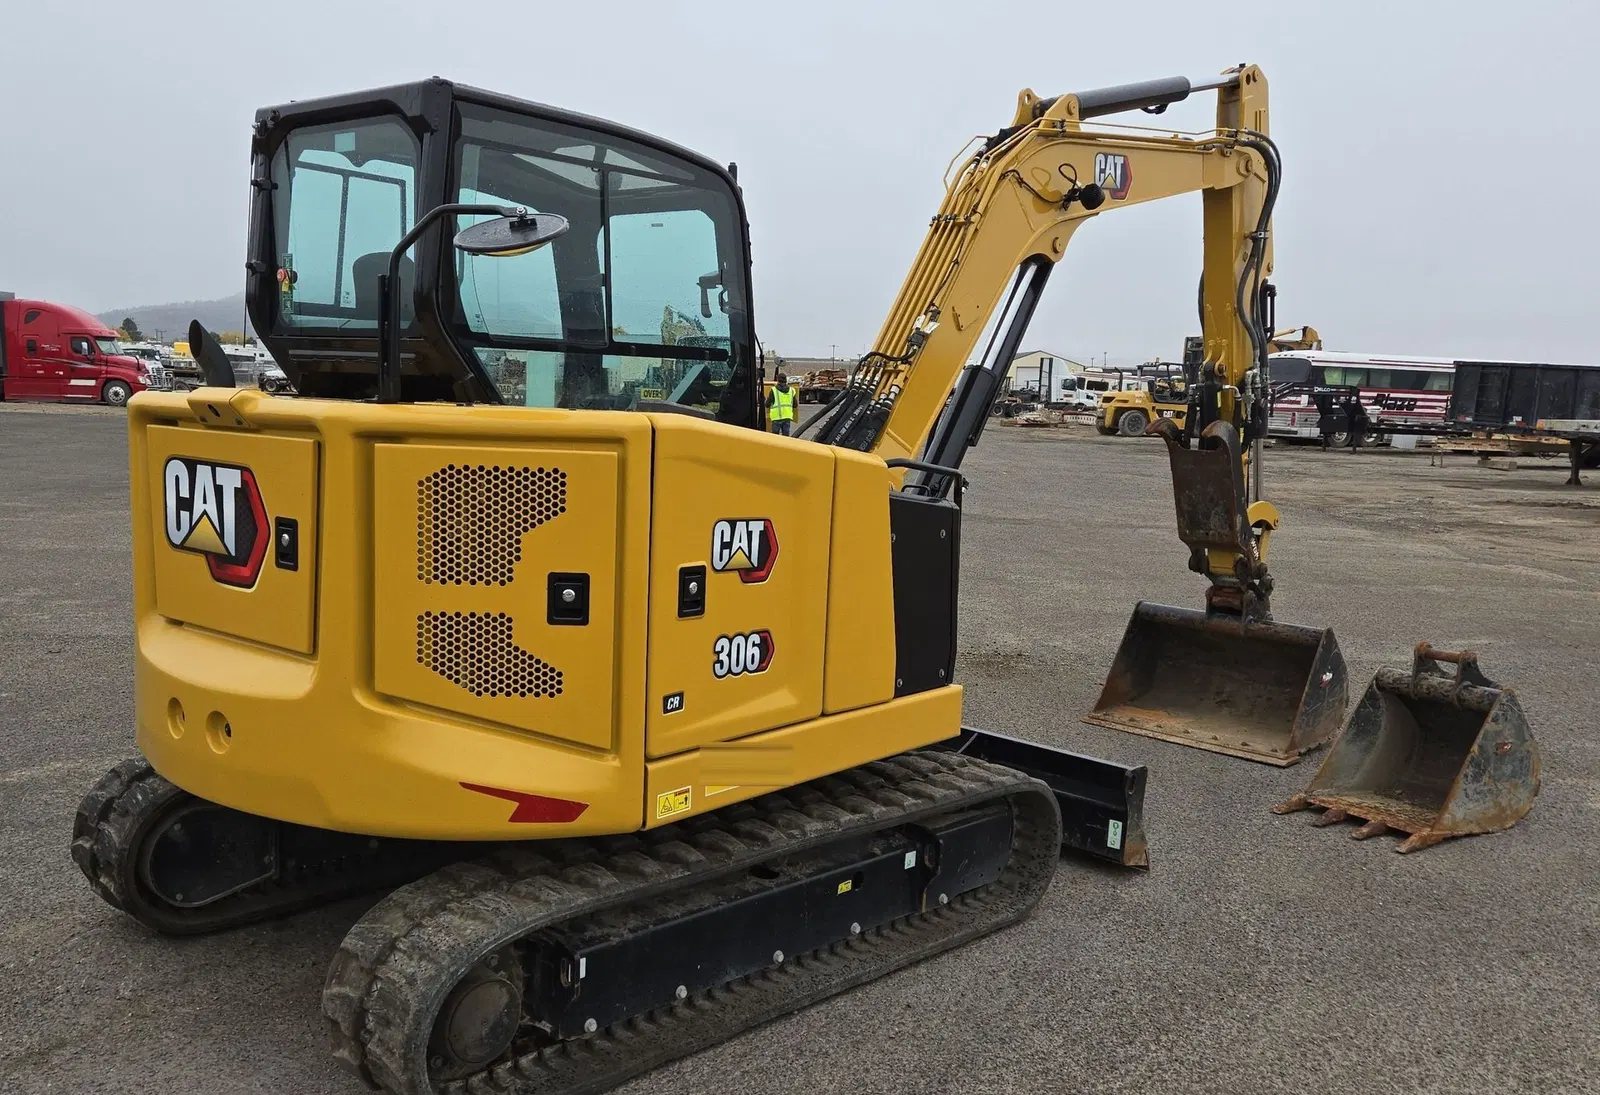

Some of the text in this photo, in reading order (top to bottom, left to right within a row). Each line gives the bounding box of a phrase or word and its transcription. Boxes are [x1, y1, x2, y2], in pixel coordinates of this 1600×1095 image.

[1096, 153, 1124, 189] CAT
[1163, 410, 1174, 418] CAT
[1374, 393, 1417, 411] Blaze
[165, 459, 242, 556] CAT
[713, 520, 765, 570] CAT
[714, 632, 761, 677] 306
[667, 695, 680, 711] CR
